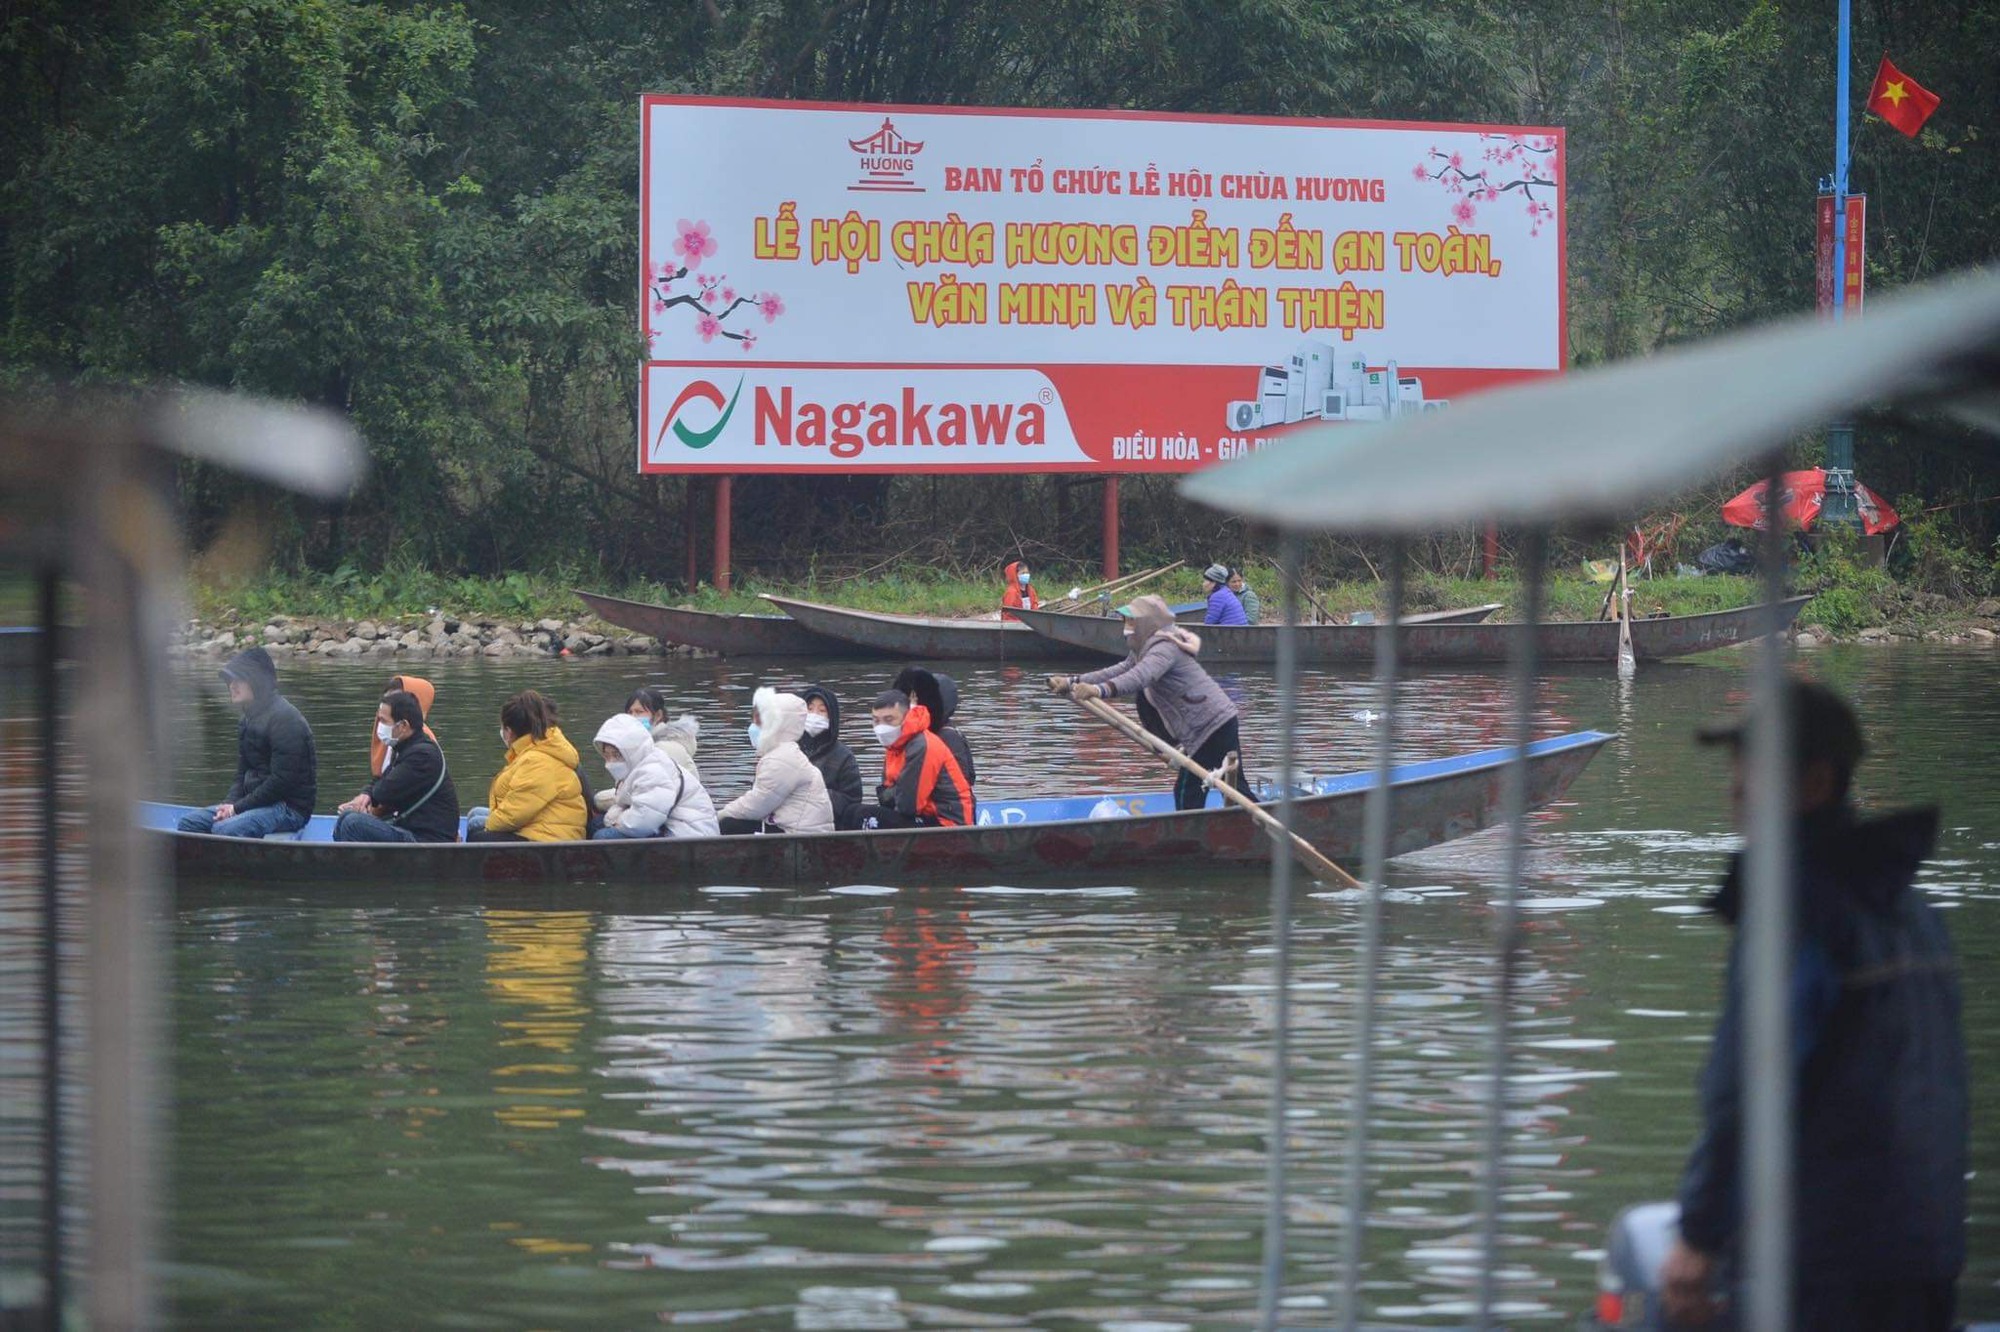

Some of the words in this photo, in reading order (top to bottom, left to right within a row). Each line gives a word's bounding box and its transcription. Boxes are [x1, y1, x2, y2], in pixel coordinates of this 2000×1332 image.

[860, 157, 914, 171] HƯƠNG
[945, 167, 1002, 192] BAN
[1009, 158, 1044, 193] TỔ
[1052, 165, 1121, 195] CHỨC
[1129, 163, 1160, 195] LỄ
[1168, 168, 1212, 202] HỘI
[1220, 171, 1288, 200] CHÙA
[1295, 176, 1385, 203] HƯƠNG
[754, 201, 800, 260] LỄ
[812, 211, 880, 274] HỘI
[892, 213, 994, 267] CHÙA
[1005, 221, 1138, 269] HƯƠNG
[1148, 210, 1239, 268] ĐIỂM
[1249, 213, 1323, 271] ĐẾN
[1334, 231, 1384, 274] AN
[1394, 226, 1502, 277] TOÀN,
[906, 274, 987, 328] VĂN
[999, 284, 1095, 329] MINH
[1105, 276, 1157, 330] VÀ
[1166, 278, 1267, 331] THÂN
[1276, 280, 1384, 341] THIỆN
[1113, 429, 1156, 460] ĐIỀU
[1161, 432, 1200, 460] HÒA
[1218, 437, 1249, 461] GIA
